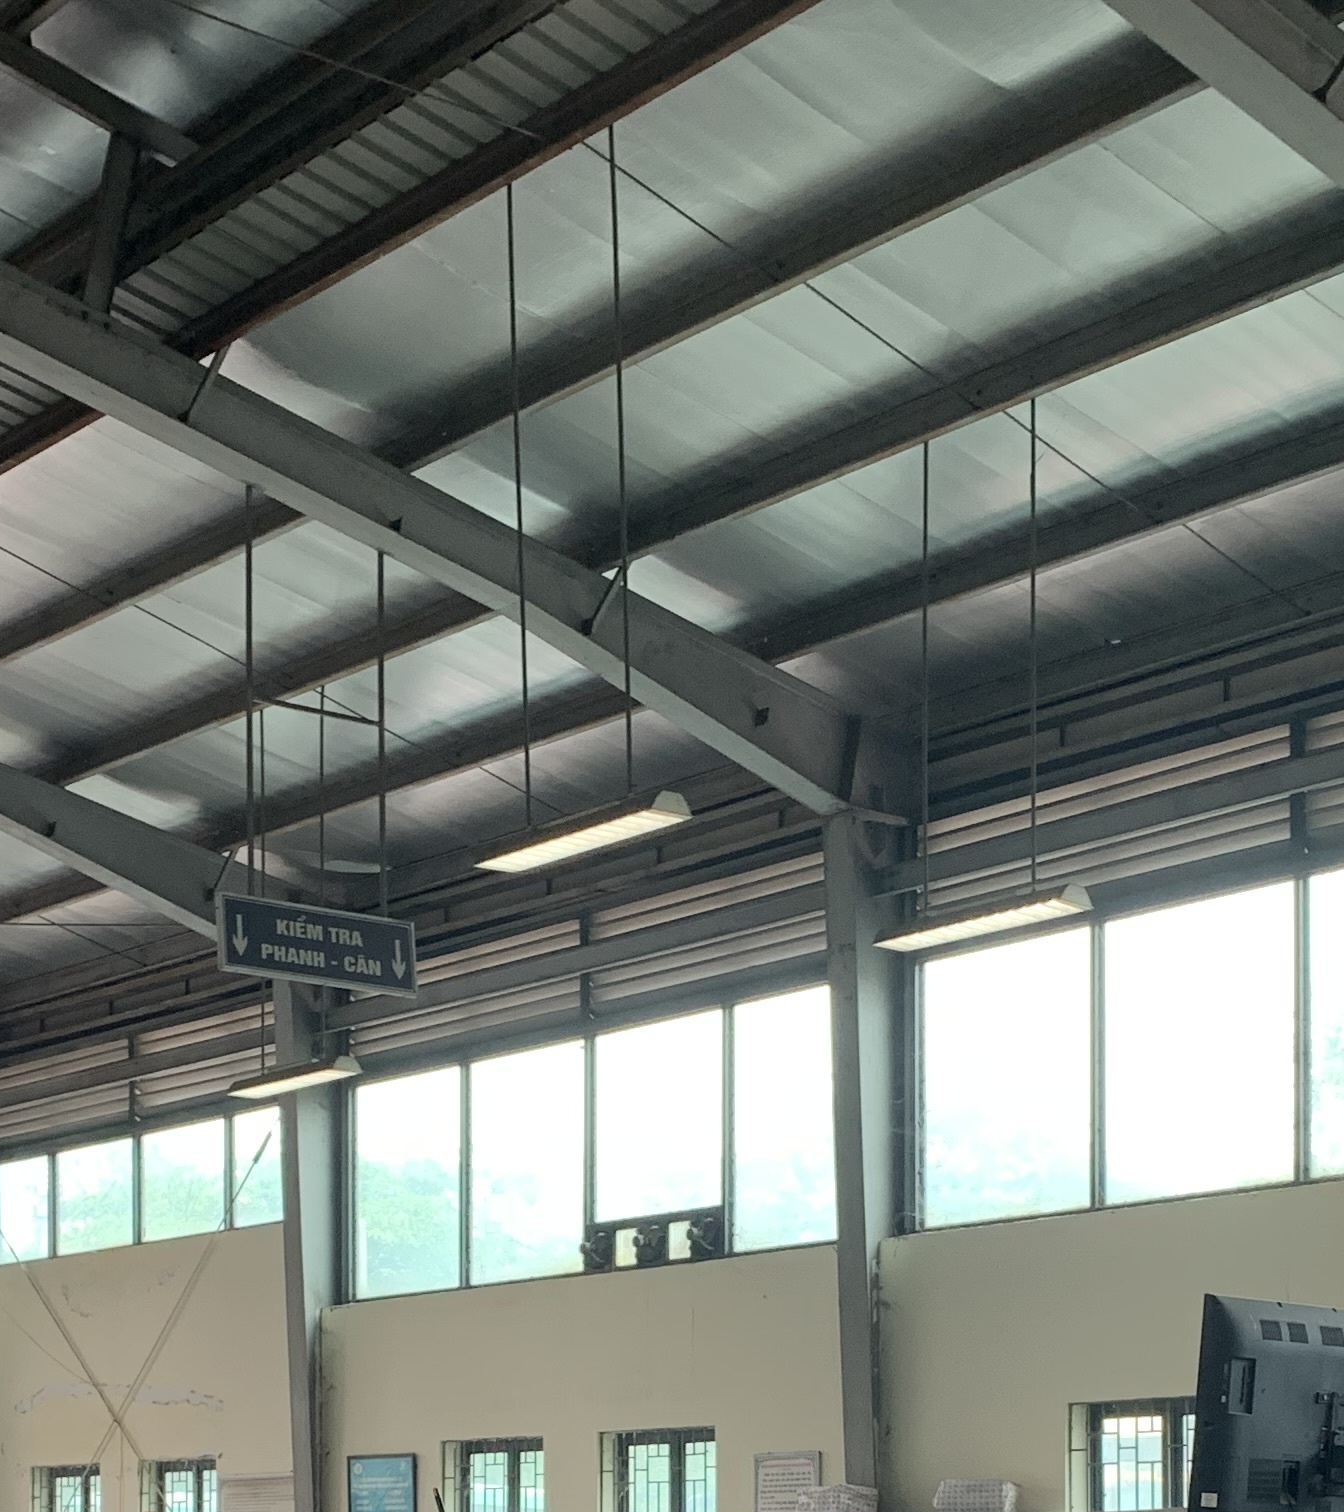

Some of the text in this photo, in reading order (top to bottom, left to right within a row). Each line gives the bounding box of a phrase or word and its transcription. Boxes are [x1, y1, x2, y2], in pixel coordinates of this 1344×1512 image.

[276, 915, 363, 947] KIỂM TRA
[261, 943, 326, 968] PHANH
